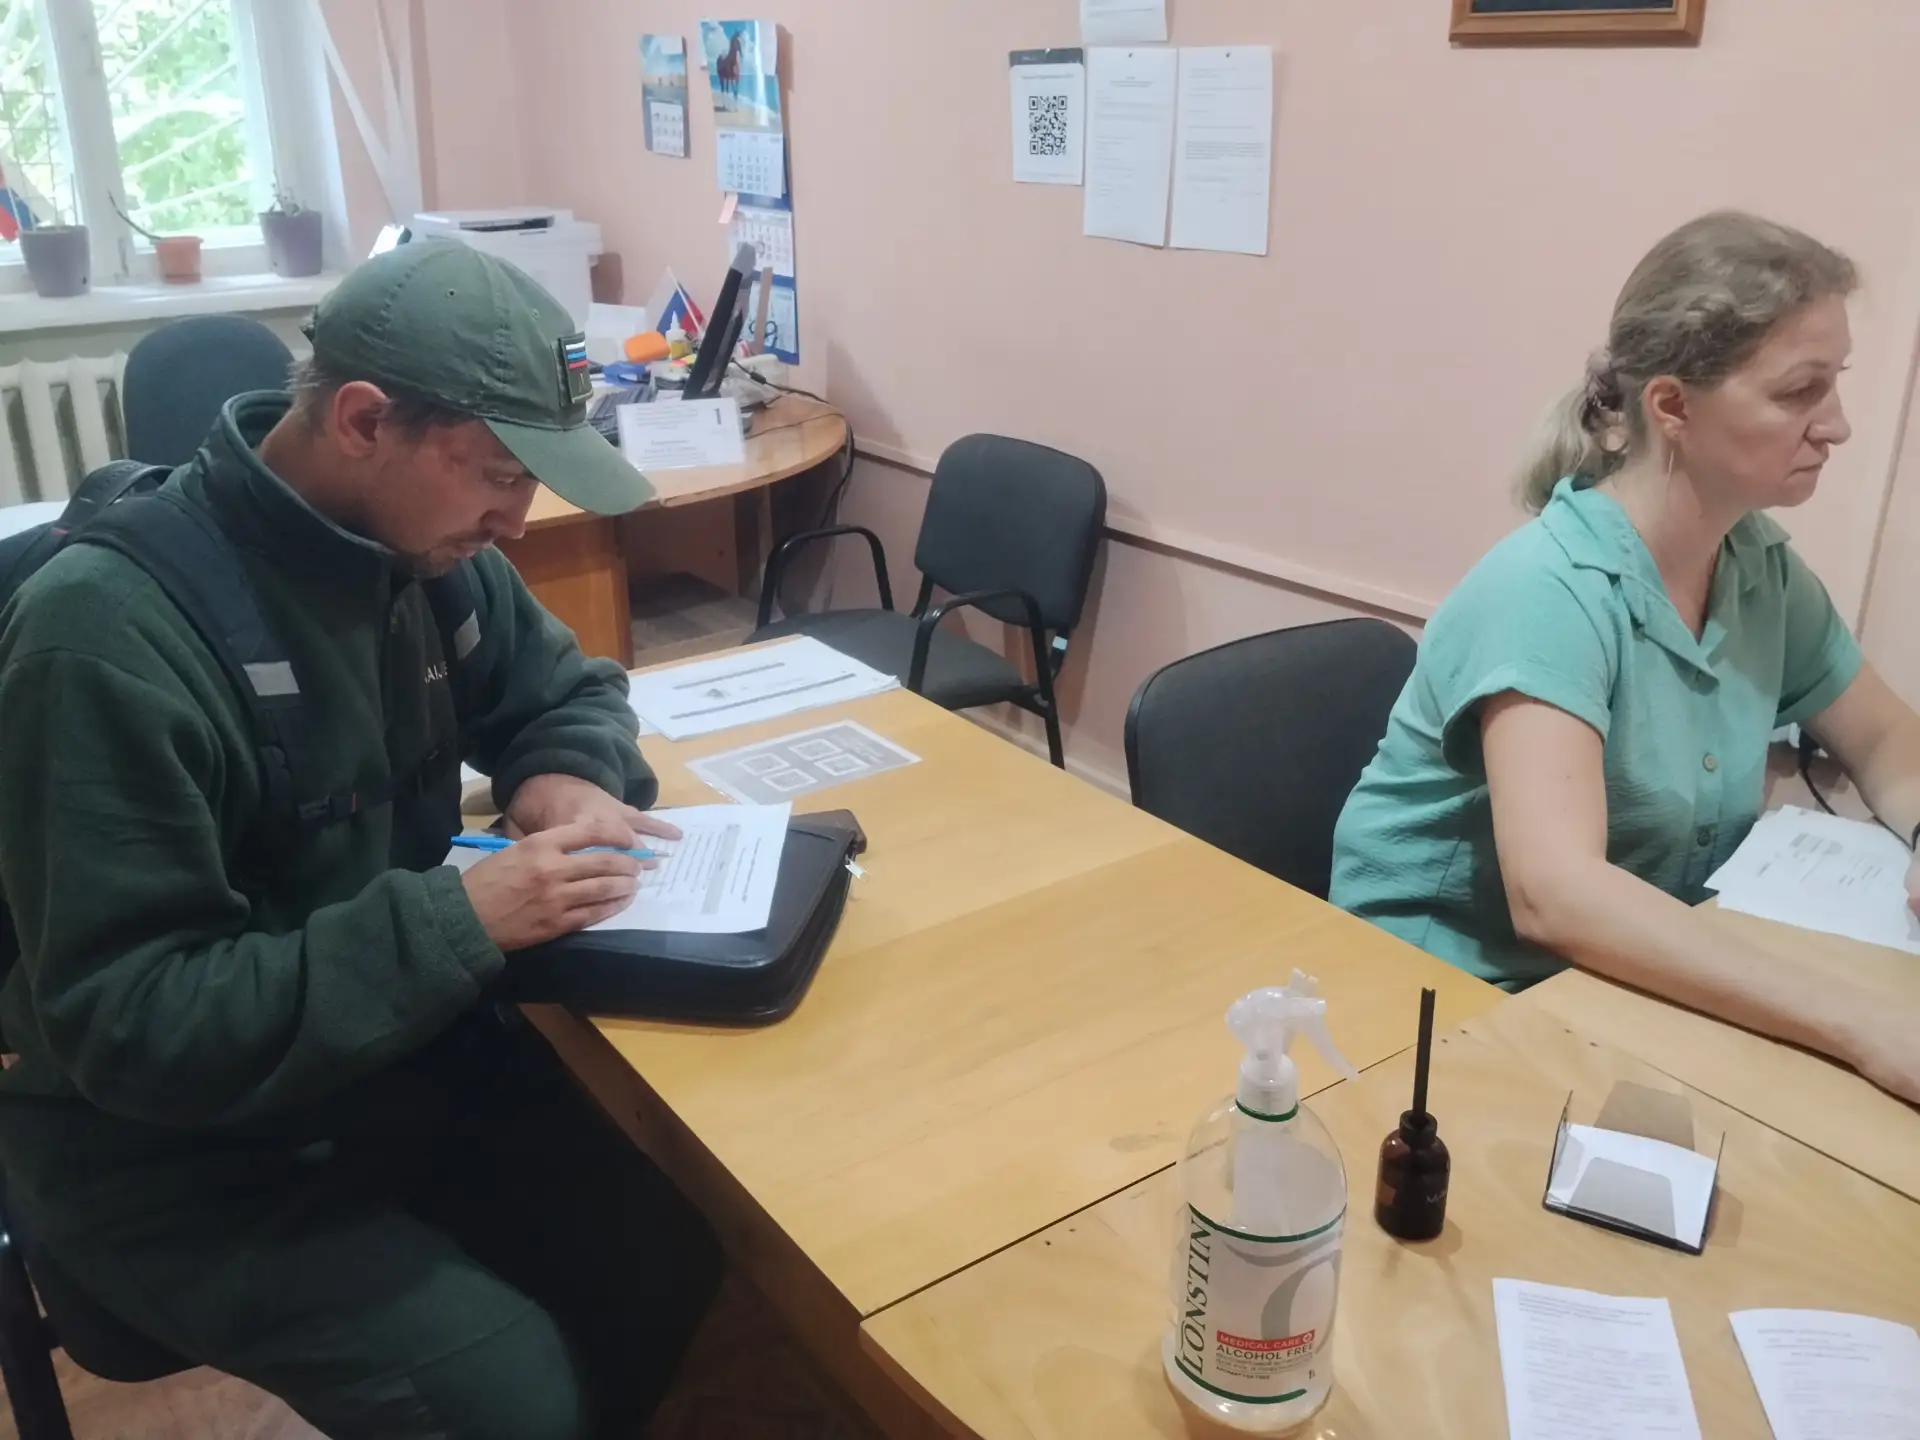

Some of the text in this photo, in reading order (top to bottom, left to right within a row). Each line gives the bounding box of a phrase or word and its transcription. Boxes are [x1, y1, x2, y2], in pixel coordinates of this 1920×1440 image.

[713, 407, 722, 426] 1
[1181, 1215, 1211, 1375] LONSTIN
[1220, 1333, 1301, 1350] MEDICAL CARE
[1216, 1344, 1282, 1360] ALCOHOL
